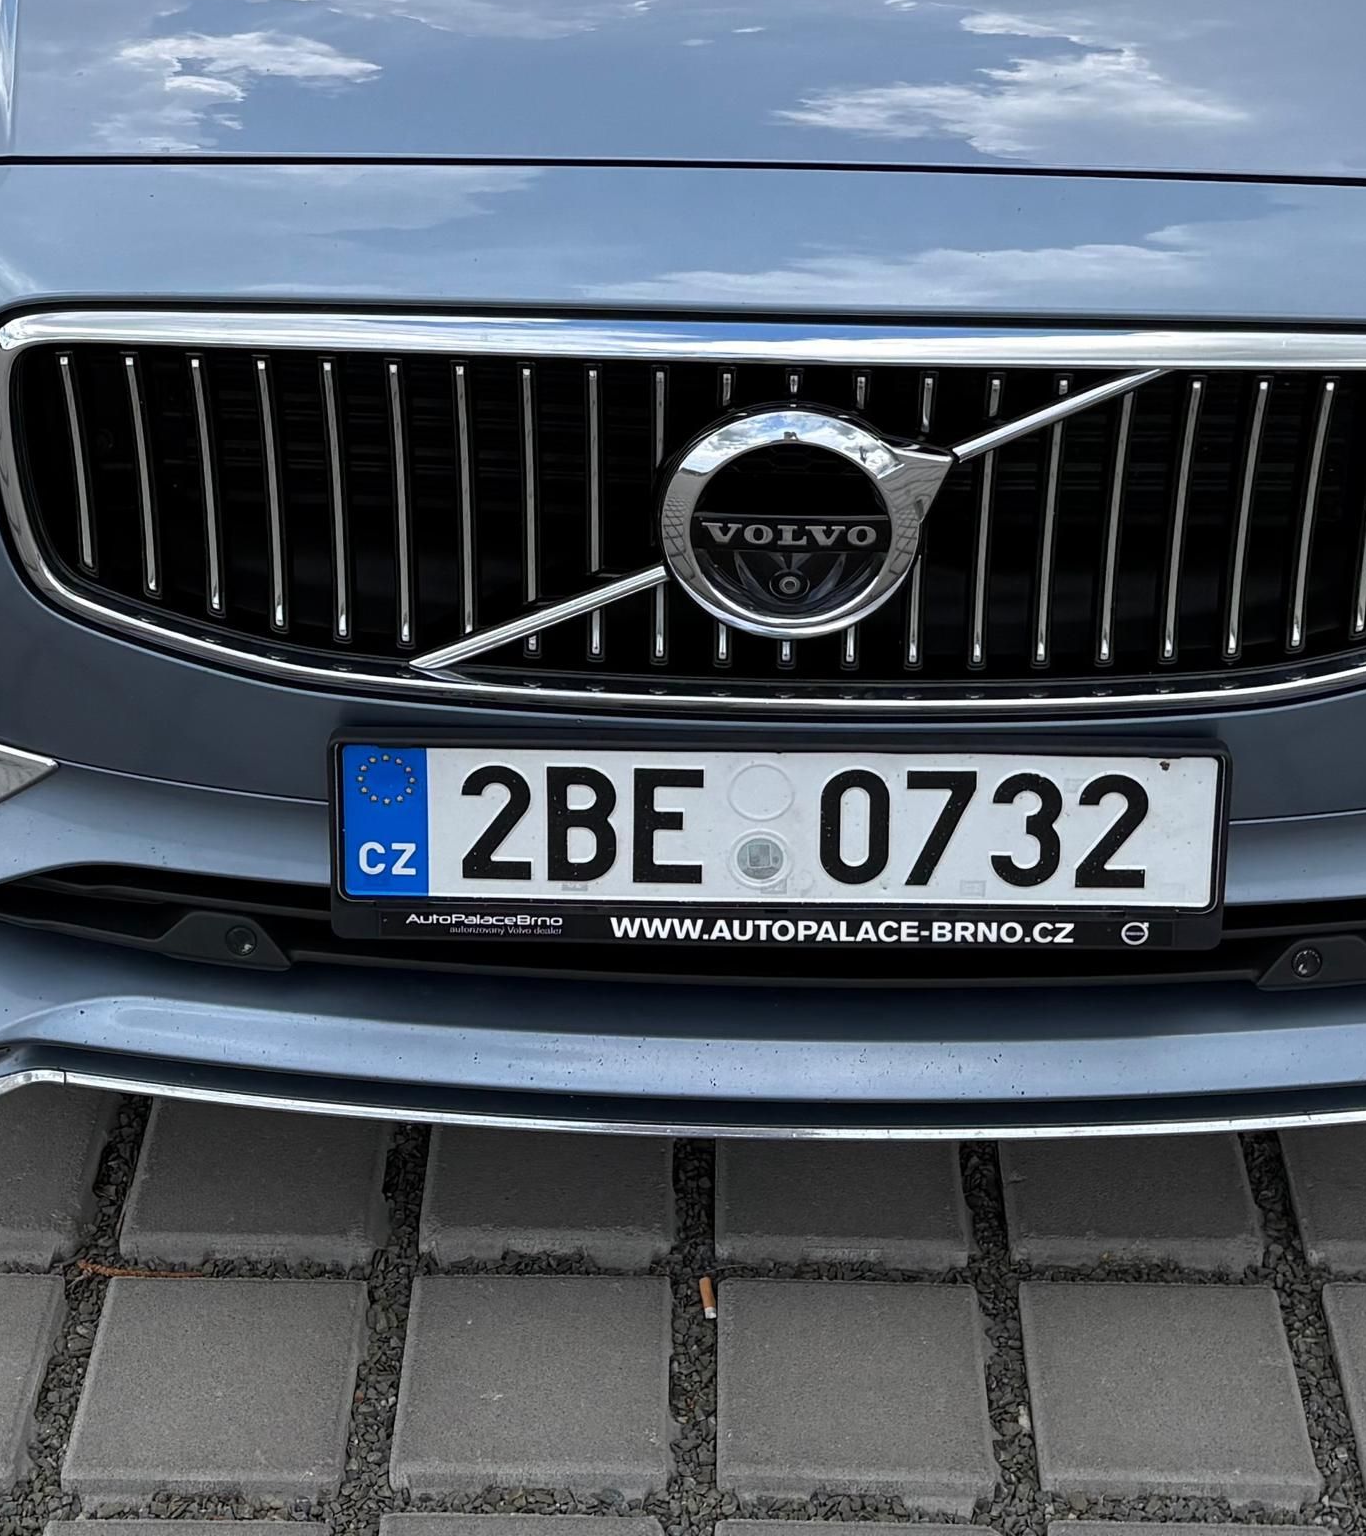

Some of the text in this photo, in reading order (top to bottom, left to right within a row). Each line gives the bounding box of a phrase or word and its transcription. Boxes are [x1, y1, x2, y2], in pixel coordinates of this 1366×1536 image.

[702, 522, 876, 546] VOLVO
[461, 765, 1149, 889] 2BE 0732
[359, 842, 417, 875] CZ
[406, 914, 563, 926] AutoPalaceBrno
[507, 925, 531, 934] Volvo
[534, 926, 562, 935] dealer
[610, 917, 1075, 944] WWW.AUTOPALACE-BRNO.CZ
